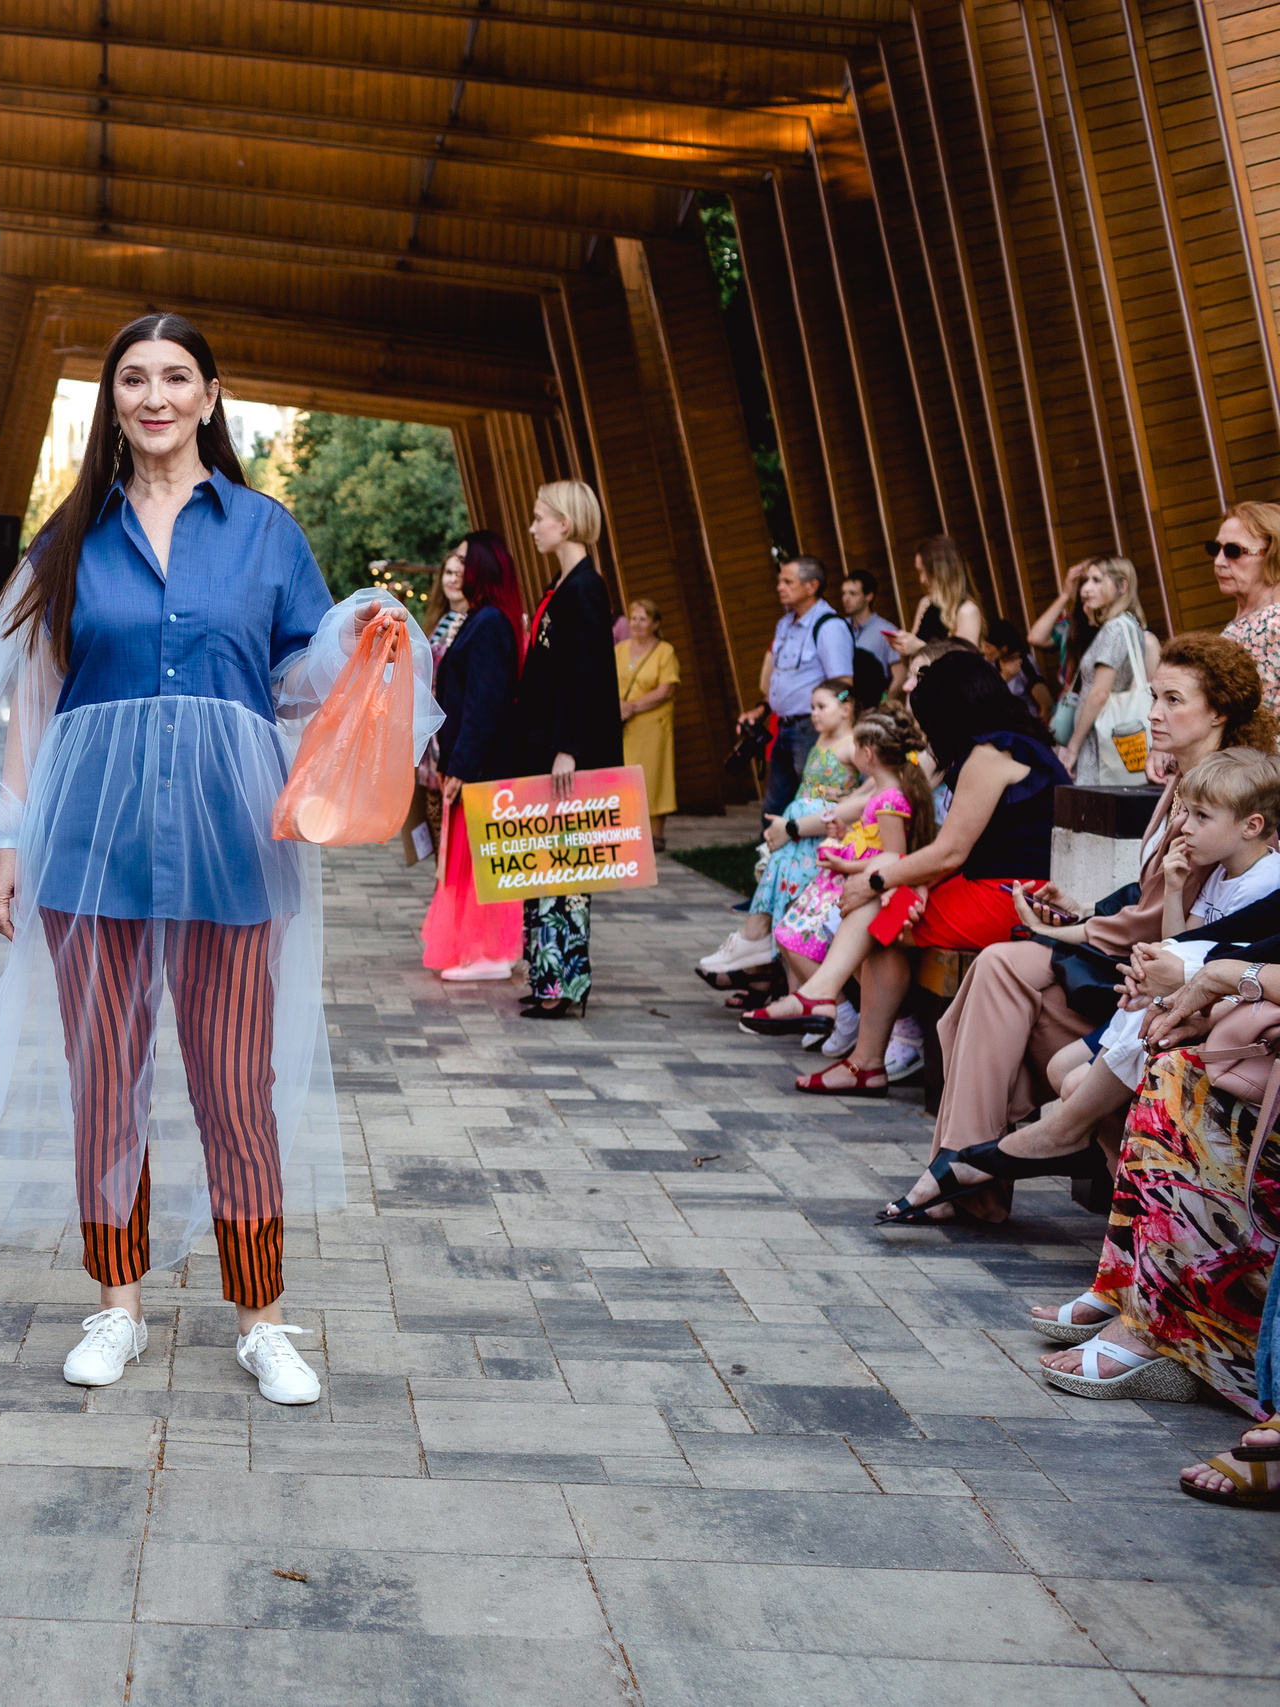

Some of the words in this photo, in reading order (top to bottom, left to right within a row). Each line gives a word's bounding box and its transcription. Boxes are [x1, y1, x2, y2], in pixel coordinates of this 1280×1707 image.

[491, 788, 549, 821] Если
[556, 795, 620, 814] наше
[485, 809, 622, 840] ПОКОЛЕНИЕ
[480, 842, 497, 857] НЕ
[502, 834, 560, 855] СДЕЛАЕТ
[564, 826, 642, 847] НЕВОЗМОЖНОЕ
[491, 853, 538, 874] НАС
[497, 861, 639, 889] немыслимое
